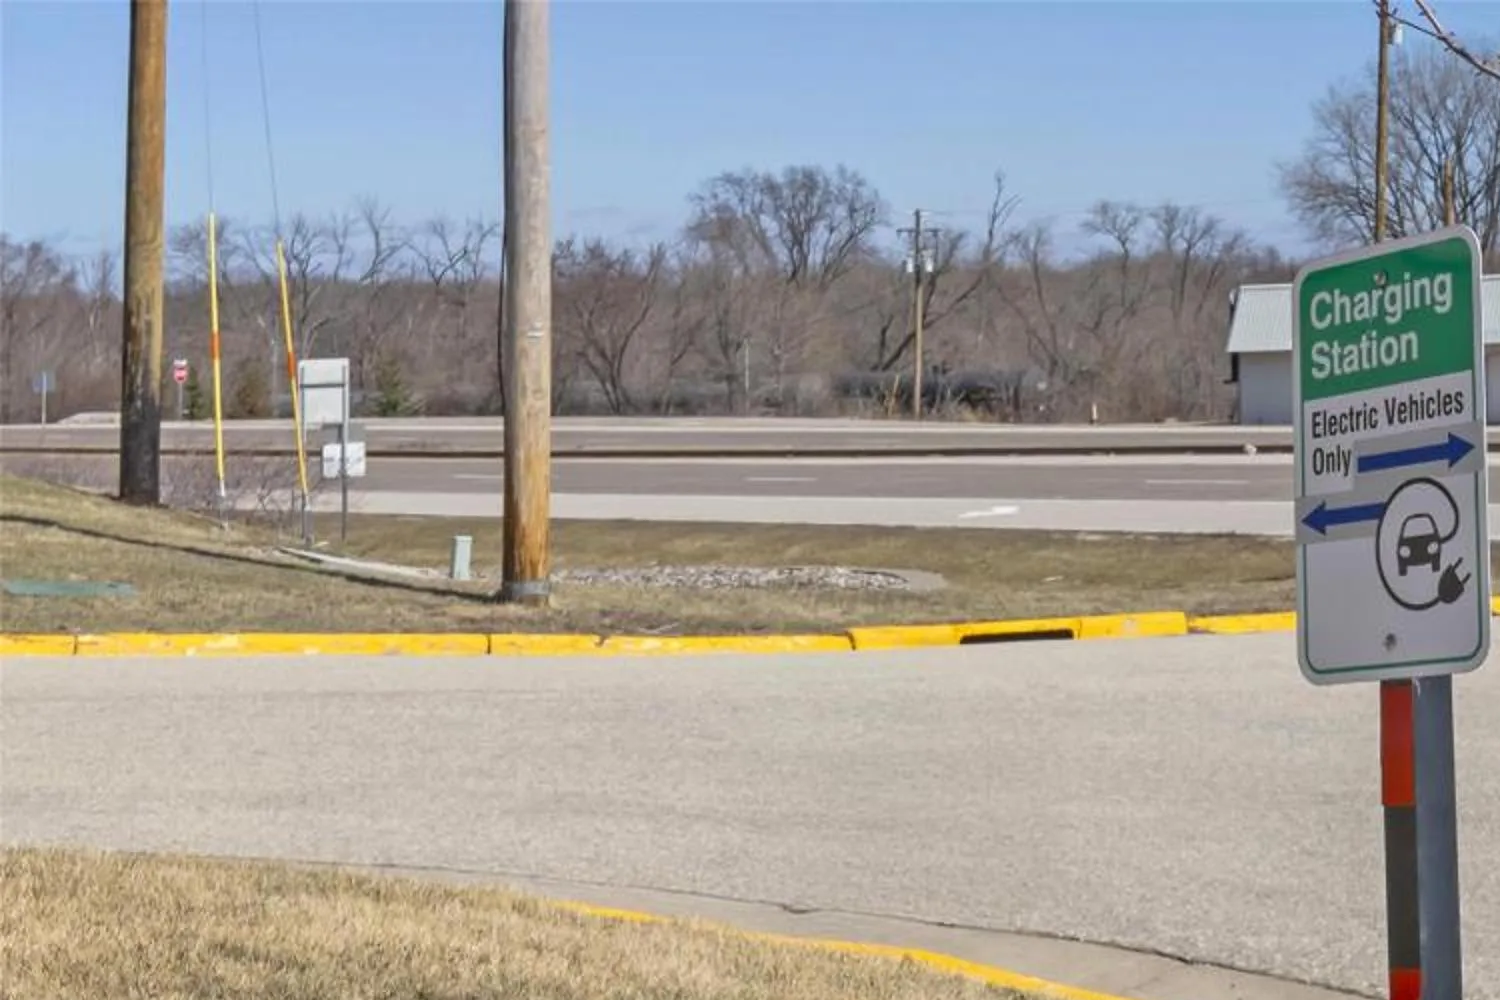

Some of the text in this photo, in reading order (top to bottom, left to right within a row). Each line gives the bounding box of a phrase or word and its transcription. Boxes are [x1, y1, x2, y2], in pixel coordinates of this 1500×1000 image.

[1310, 272, 1453, 329] Charging
[1311, 331, 1419, 379] Station
[1312, 389, 1464, 438] Electric Vehicles
[1313, 446, 1352, 476] Only
